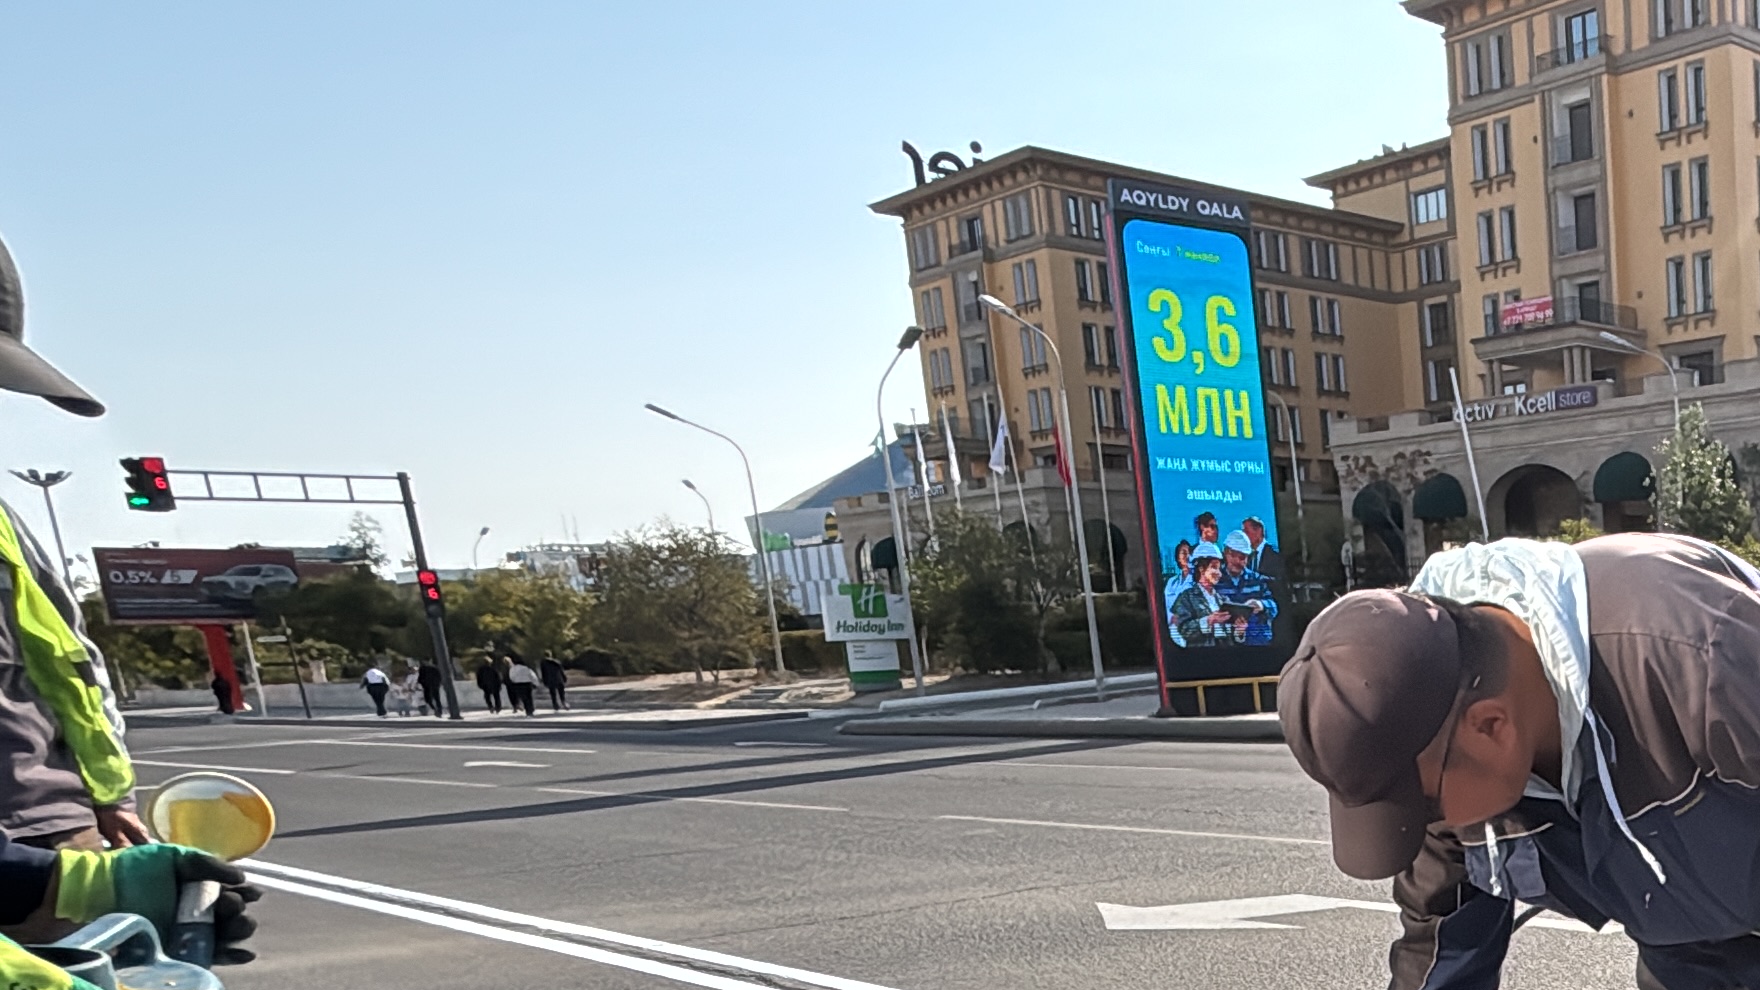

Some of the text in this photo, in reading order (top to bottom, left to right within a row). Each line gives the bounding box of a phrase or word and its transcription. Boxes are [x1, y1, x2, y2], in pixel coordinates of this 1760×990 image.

[1120, 187, 1245, 221] AQYLDY QALA
[1148, 288, 1241, 375] 3,6
[1155, 383, 1253, 439] МЛН
[1514, 390, 1556, 417] Kcell
[1559, 390, 1592, 408] store
[154, 476, 167, 490] 6
[835, 619, 905, 636] Holiday Inn
